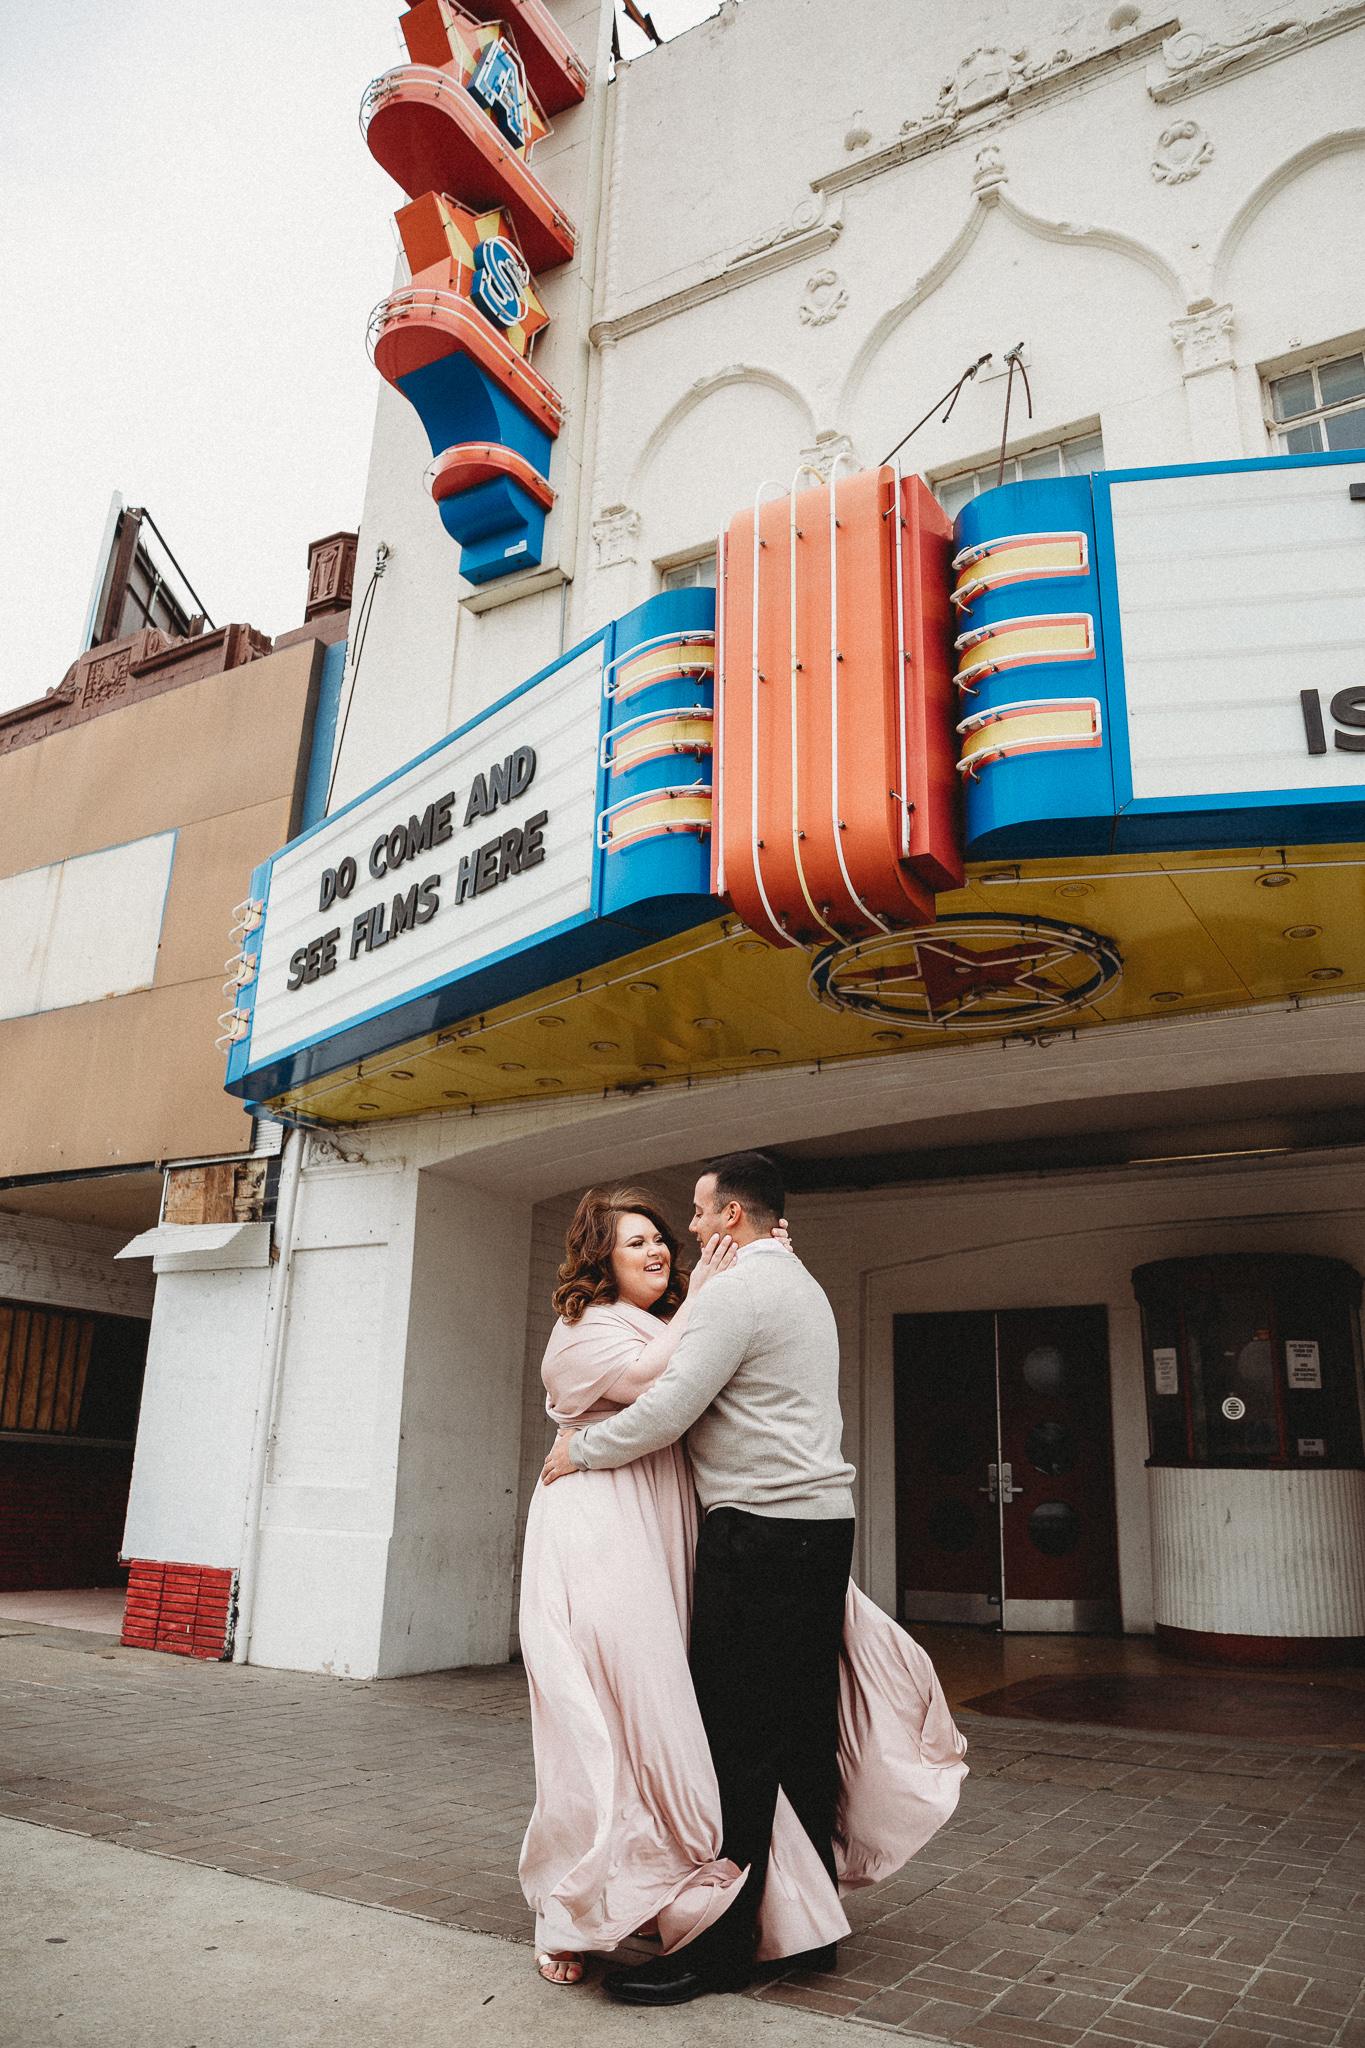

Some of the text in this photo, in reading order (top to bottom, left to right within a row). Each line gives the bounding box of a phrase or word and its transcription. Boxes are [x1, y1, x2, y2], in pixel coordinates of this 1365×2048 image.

[287, 810, 548, 991] SEE FILMS HERE
[319, 745, 537, 912] DO COME AND
